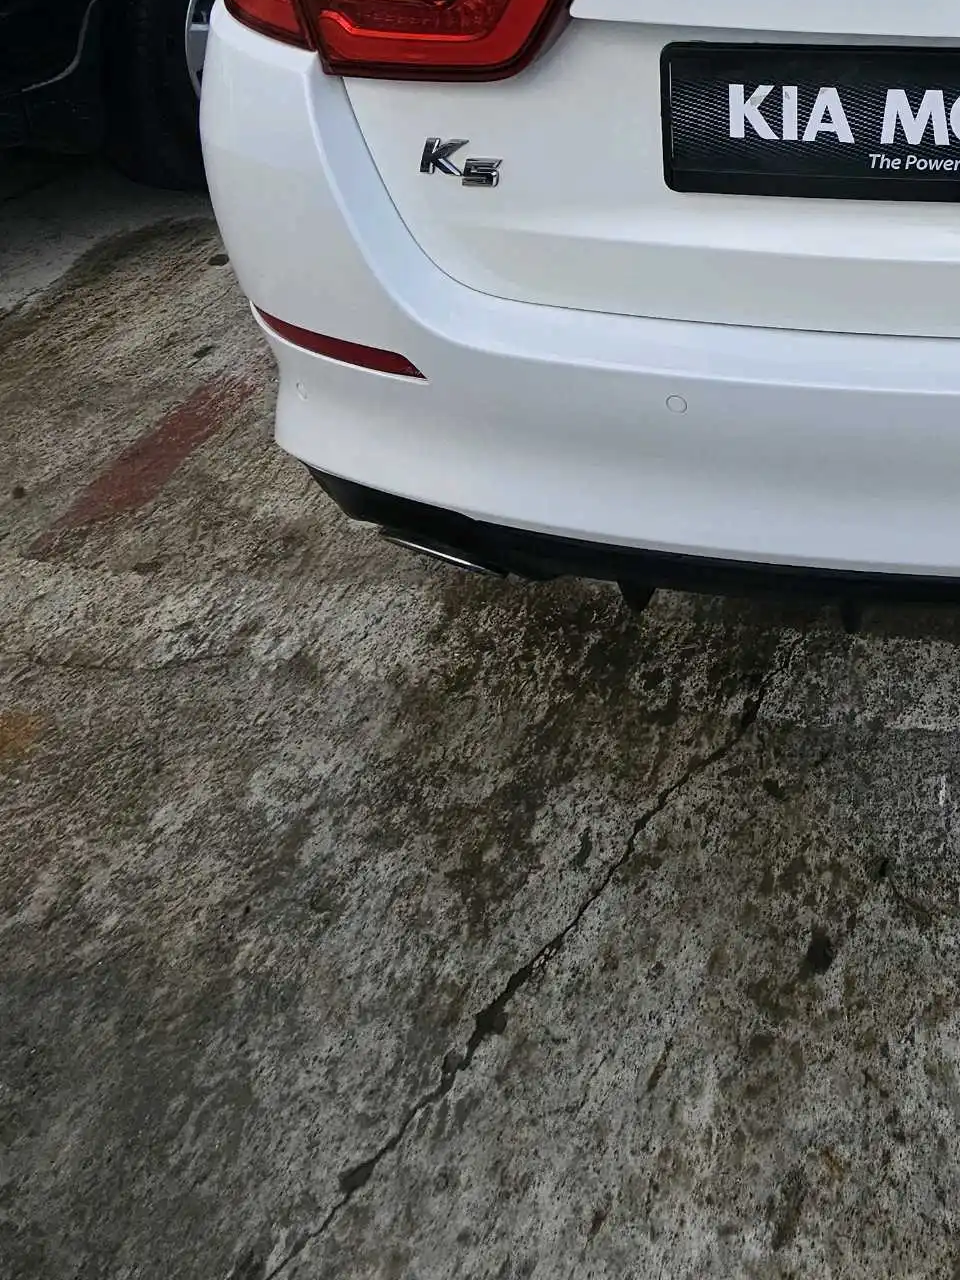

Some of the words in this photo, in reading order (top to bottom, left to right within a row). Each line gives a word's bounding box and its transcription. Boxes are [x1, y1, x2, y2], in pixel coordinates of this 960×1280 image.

[728, 83, 855, 144] KIA
[419, 136, 503, 188] K5
[868, 153, 901, 170] The
